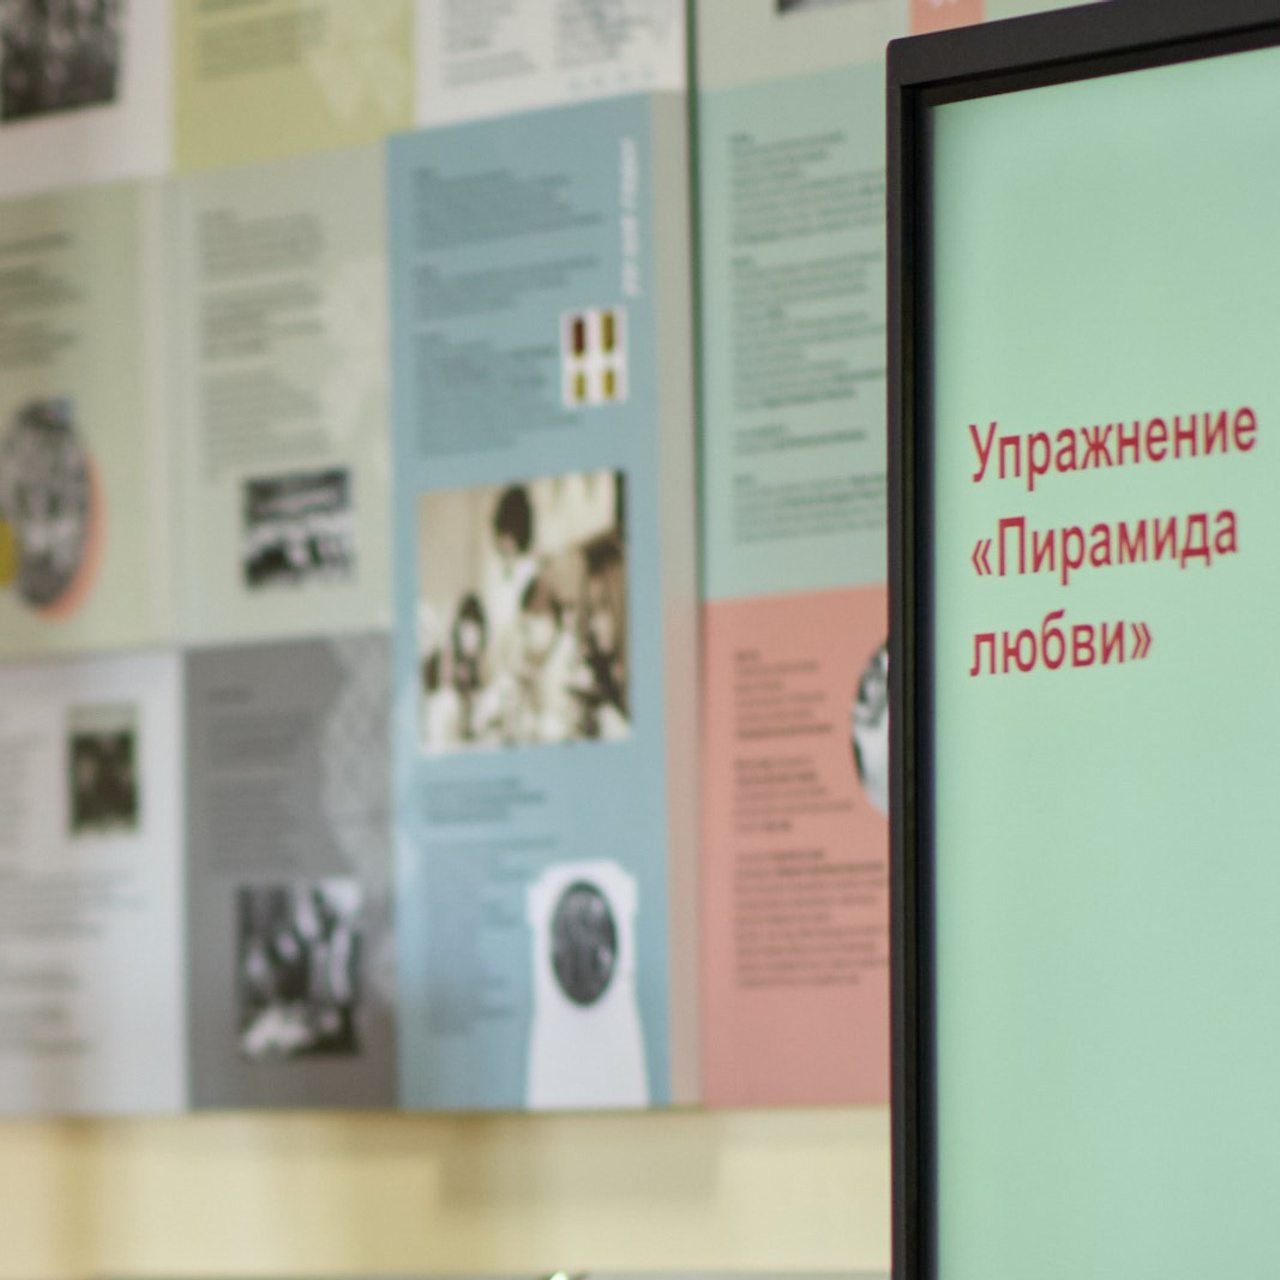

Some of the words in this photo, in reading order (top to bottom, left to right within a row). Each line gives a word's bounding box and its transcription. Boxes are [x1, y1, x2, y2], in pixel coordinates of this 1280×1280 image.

[969, 406, 1258, 491] Упражнение
[971, 508, 1238, 586] «Пирамида
[969, 608, 1152, 677] любви»
